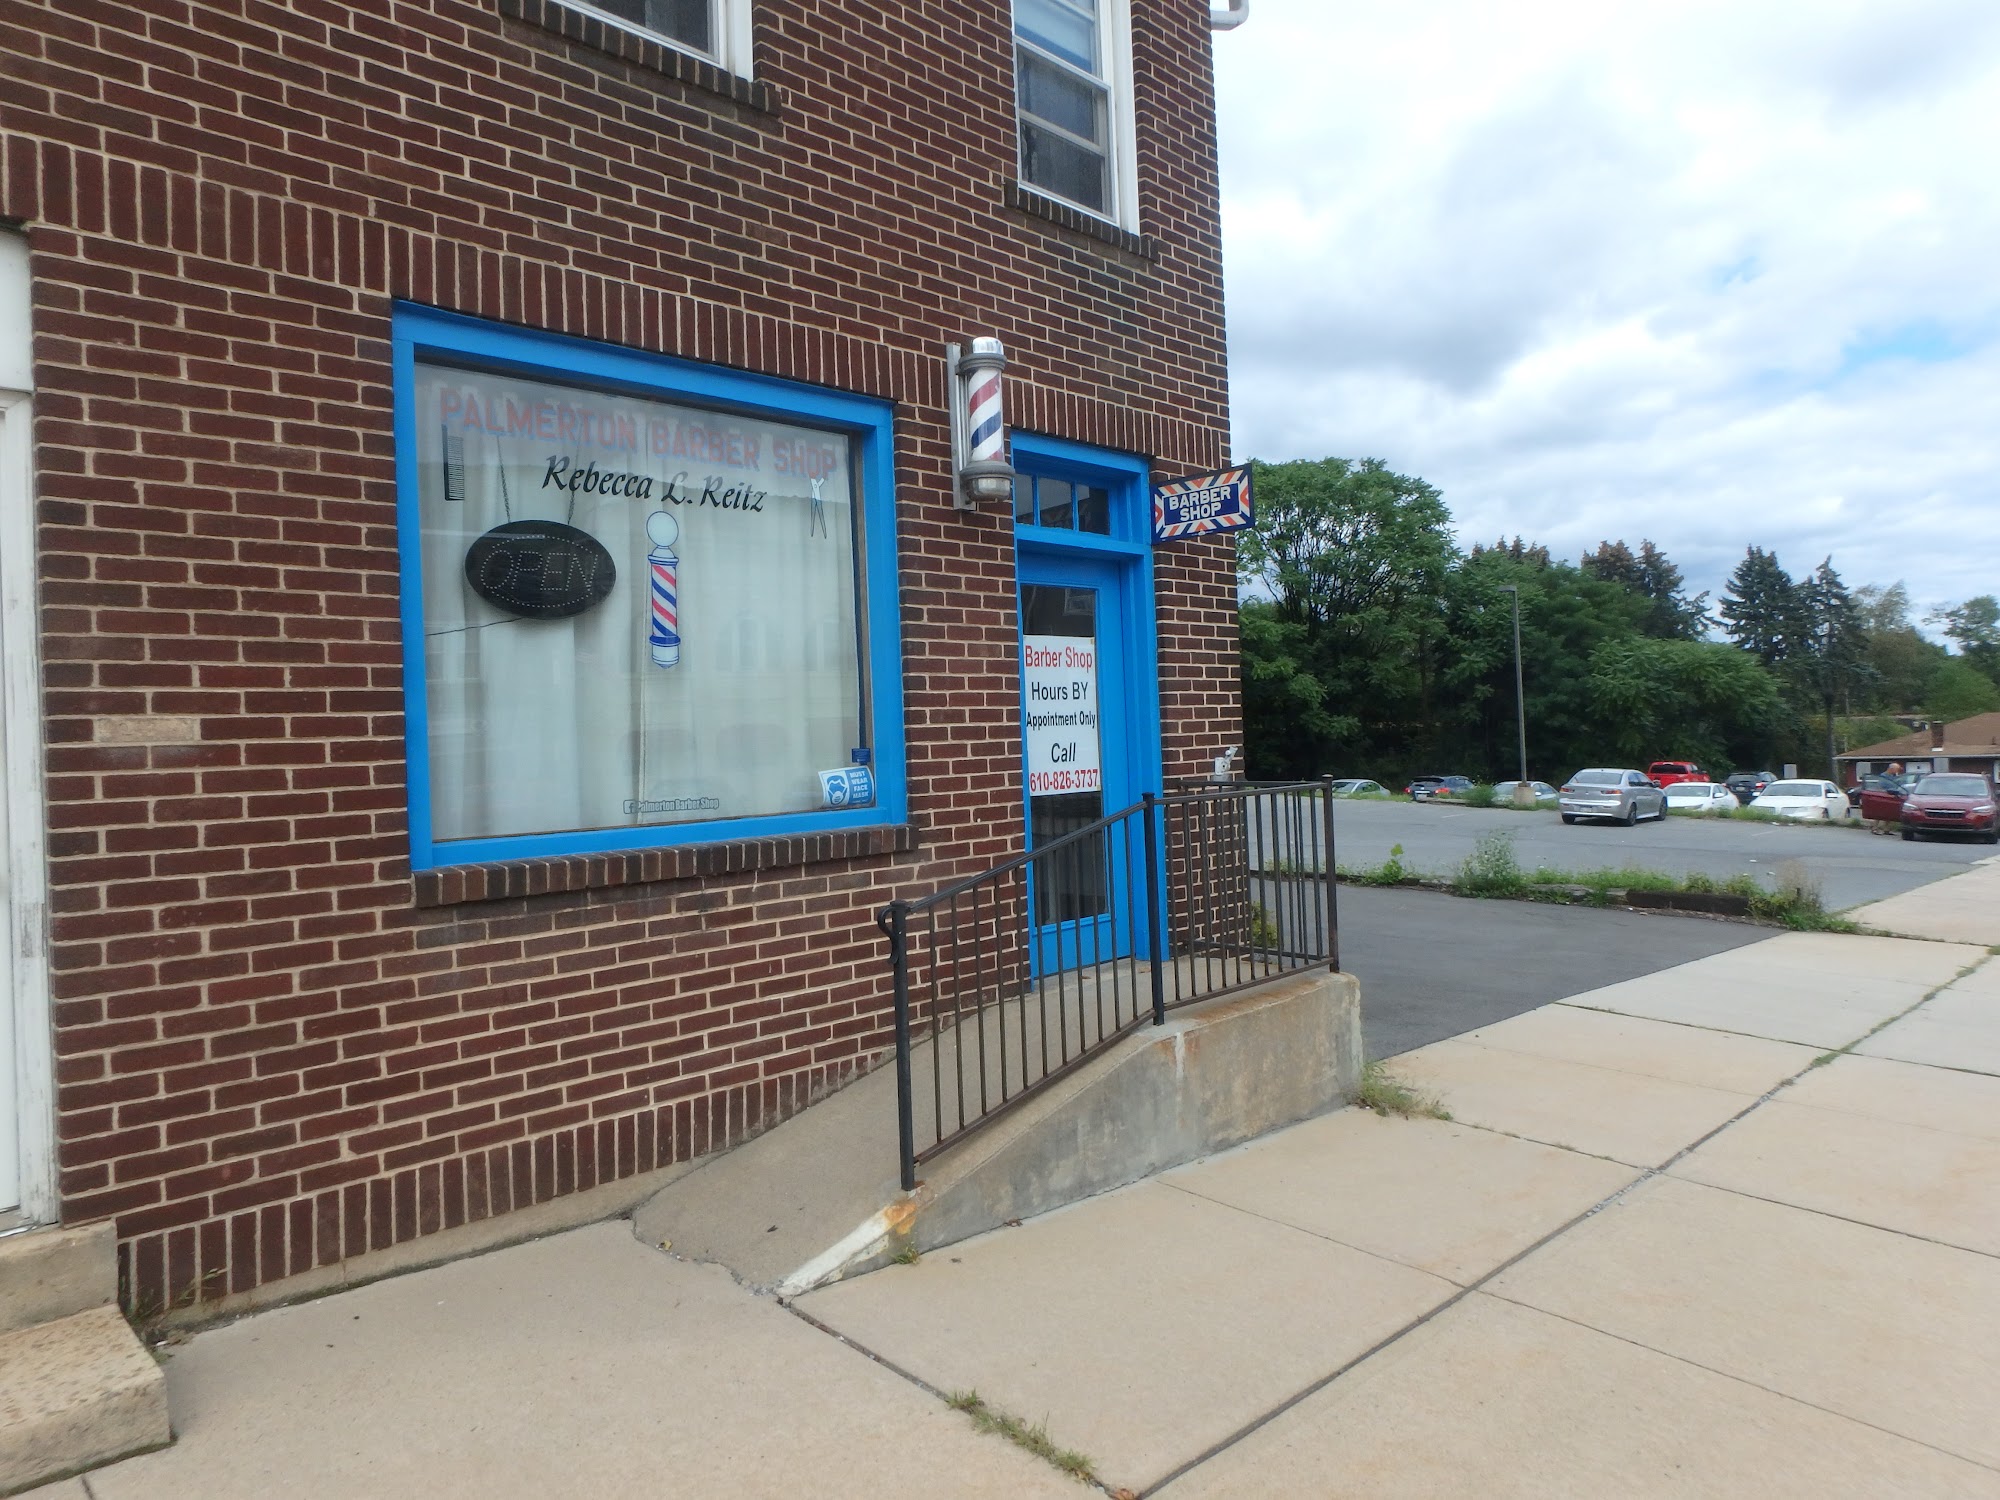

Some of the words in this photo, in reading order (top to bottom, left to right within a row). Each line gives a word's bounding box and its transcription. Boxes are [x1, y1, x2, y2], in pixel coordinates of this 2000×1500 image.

[440, 387, 638, 453] PALMERTON
[652, 419, 760, 471] BARBER
[772, 439, 837, 481] SHOP
[542, 455, 654, 499] Rebecca
[661, 471, 693, 505] L.
[700, 475, 768, 513] Reitz
[1169, 486, 1231, 511] BARBER
[1180, 502, 1222, 521] SHOP
[481, 550, 598, 591] OPEN
[1025, 645, 1062, 668] Barber
[1065, 646, 1093, 673] Shop
[1031, 681, 1068, 701] Hours
[1072, 682, 1089, 700] BY
[1026, 711, 1077, 731] Appointment
[1079, 710, 1096, 729] Only
[1051, 743, 1076, 763] Call
[1030, 769, 1098, 792] 610-826-3737
[674, 798, 700, 811] Barber
[700, 797, 719, 810] Shop
